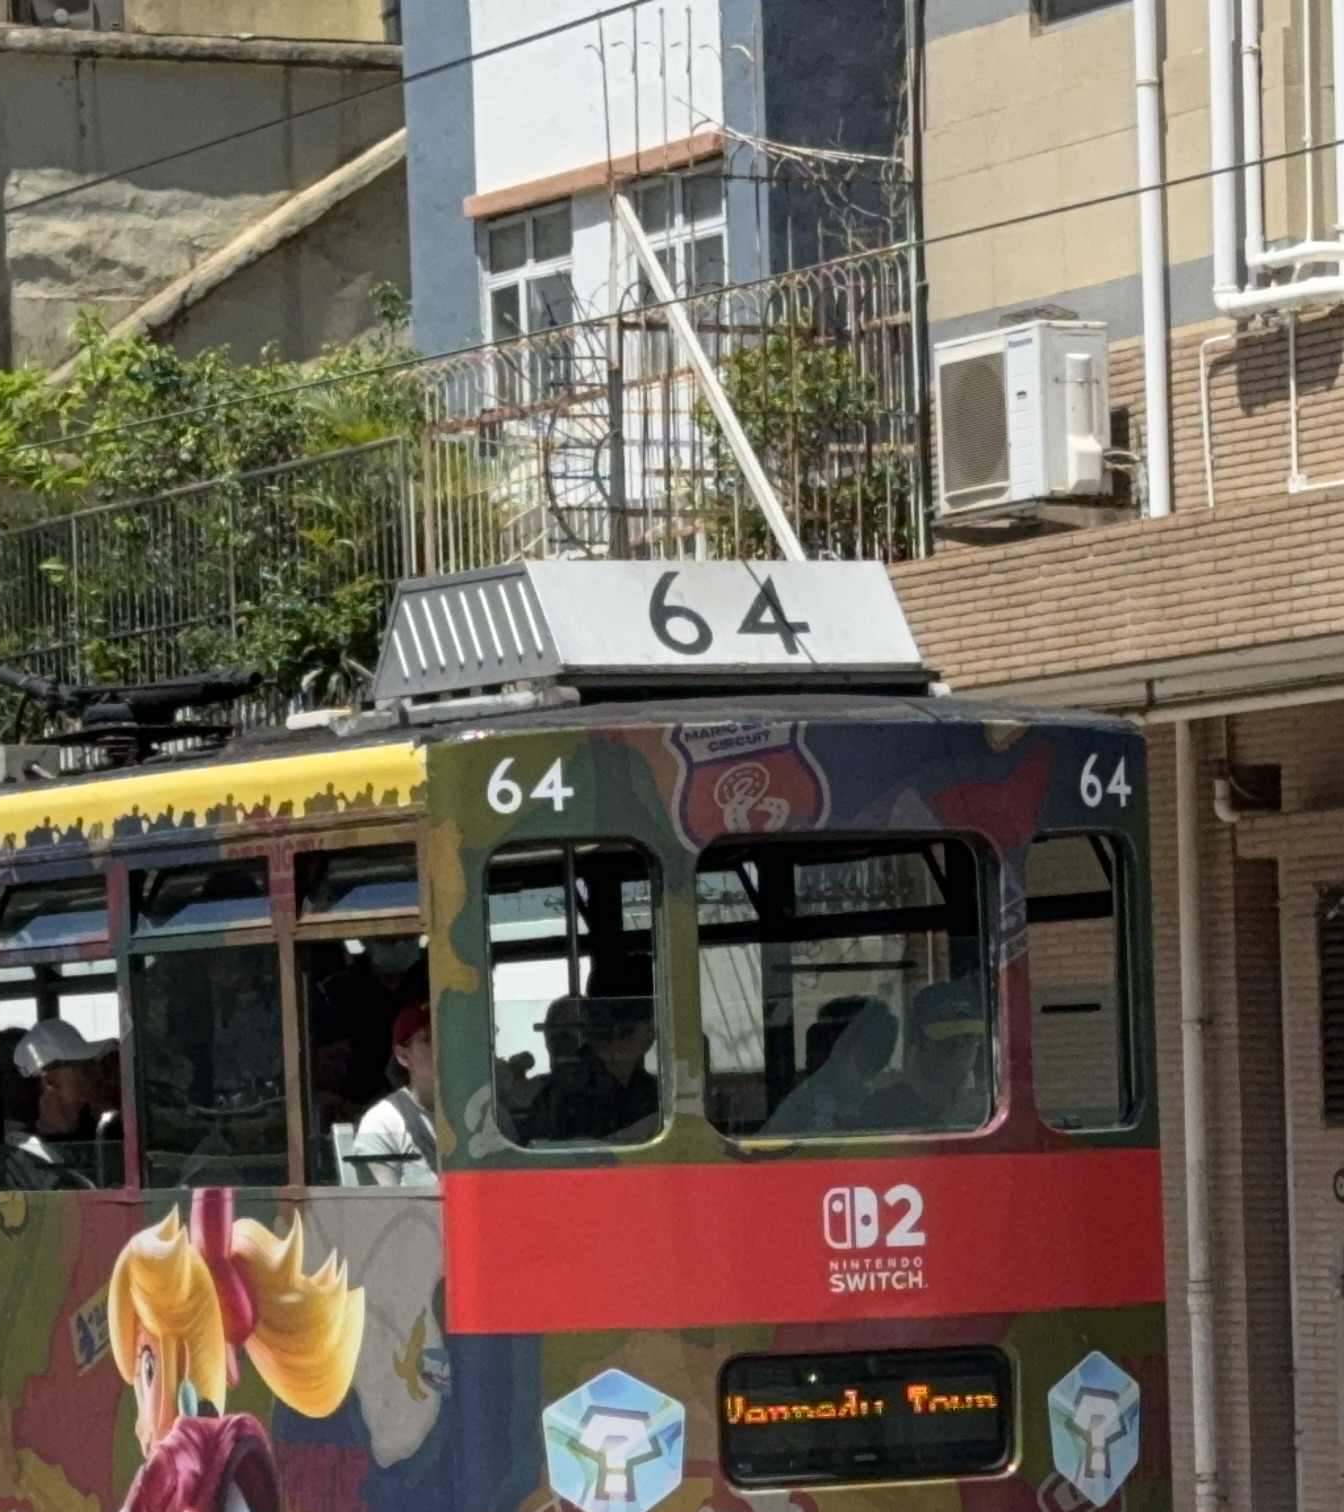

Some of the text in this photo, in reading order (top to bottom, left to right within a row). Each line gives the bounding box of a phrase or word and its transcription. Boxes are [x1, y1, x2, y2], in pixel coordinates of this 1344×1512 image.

[650, 570, 810, 656] 64
[708, 730, 772, 752] CIRCUIT
[487, 757, 574, 814] 64
[1080, 753, 1132, 808] 64
[829, 1256, 923, 1271] NINTENDO
[829, 1271, 926, 1293] SWITCH
